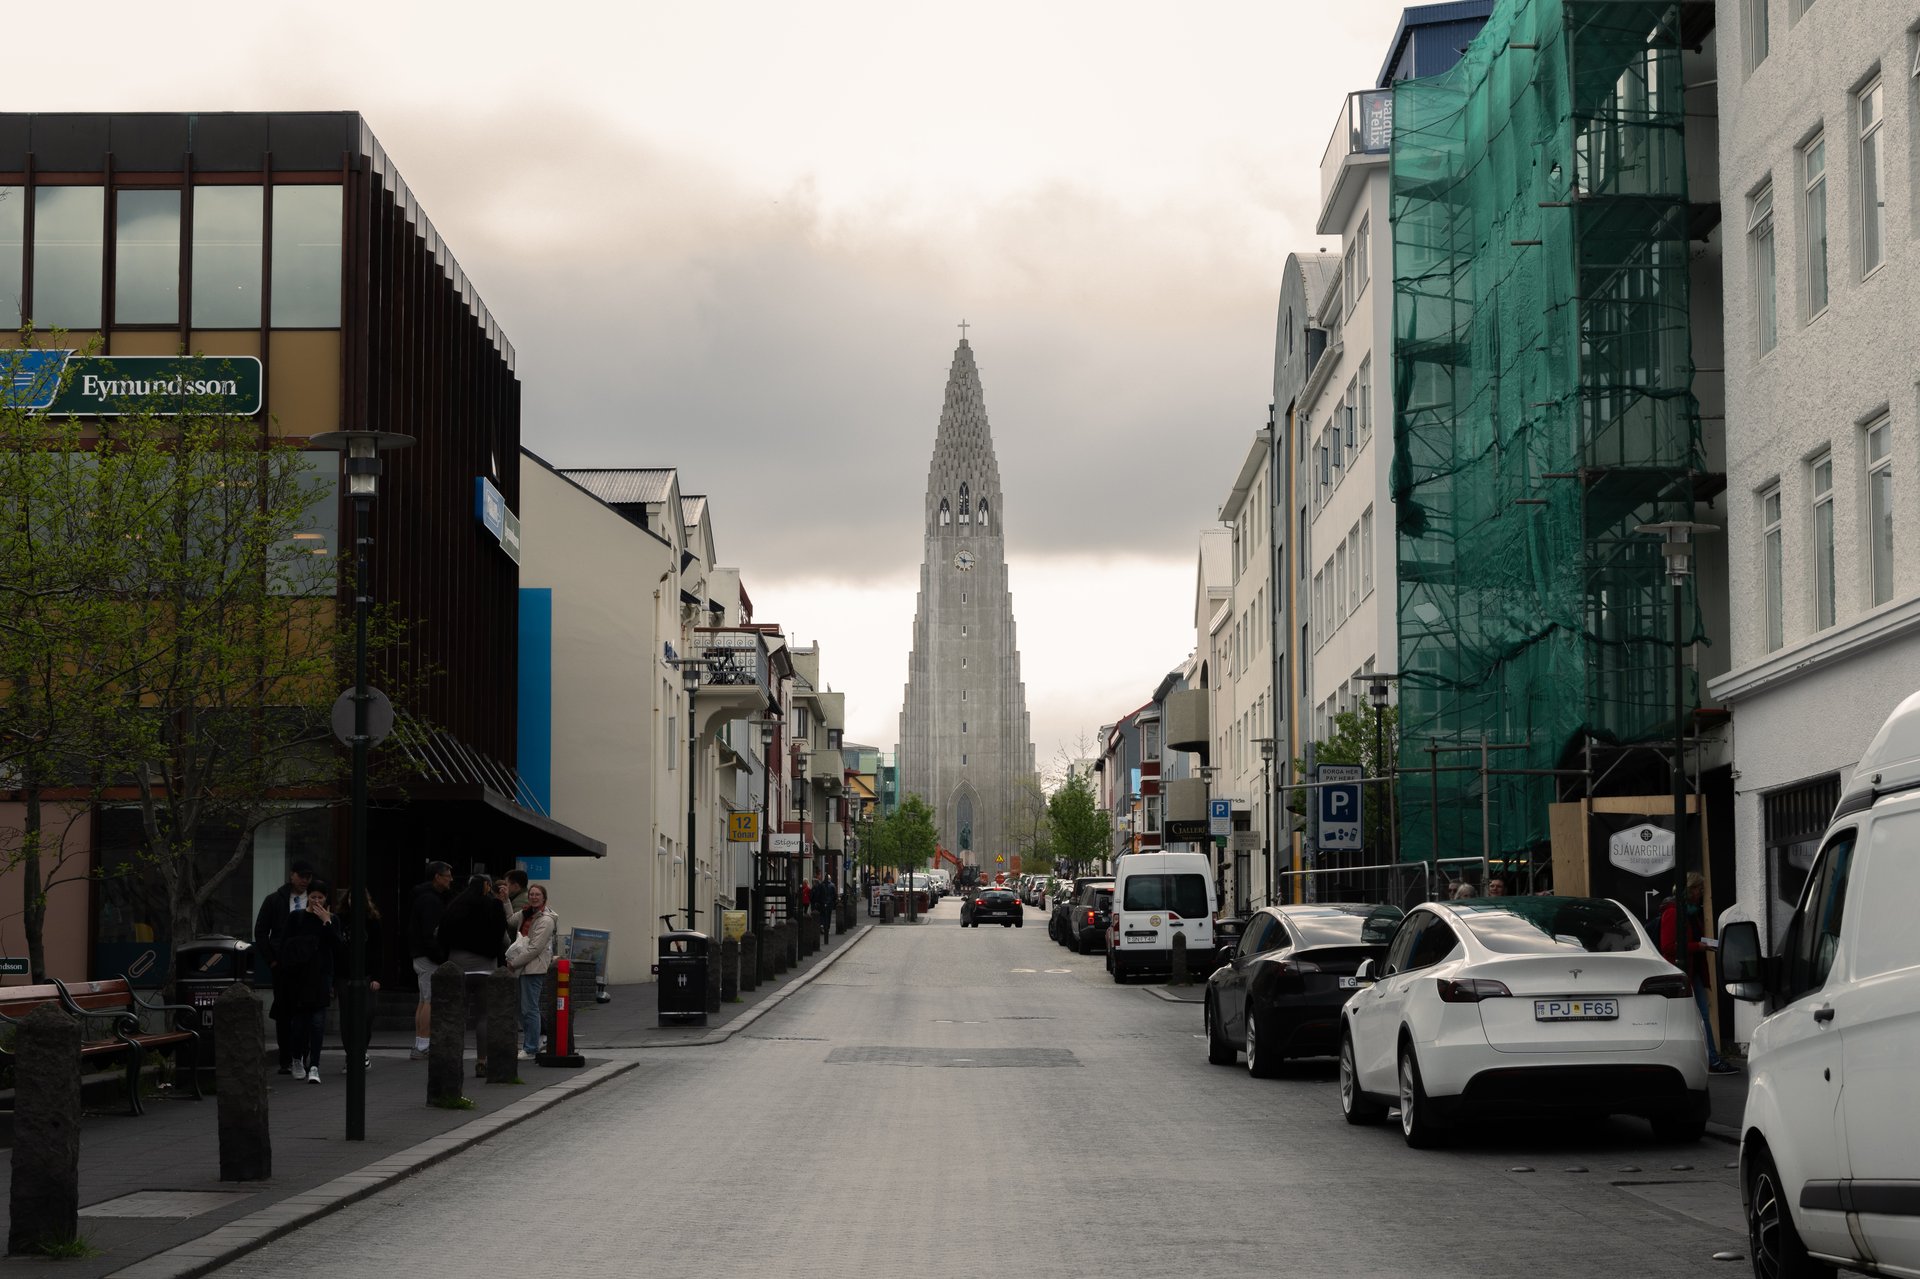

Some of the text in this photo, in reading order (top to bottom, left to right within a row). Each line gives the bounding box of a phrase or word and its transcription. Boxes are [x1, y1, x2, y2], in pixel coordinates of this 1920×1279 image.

[1370, 109, 1383, 146] Felix
[82, 374, 237, 401] Eymundsson
[1216, 803, 1226, 815] P
[1331, 790, 1350, 816] P
[736, 816, 752, 830] 12
[732, 829, 755, 839] Tónar
[1613, 842, 1675, 857] SJÁVARGRILLI
[1550, 1002, 1614, 1016] PJ F65
